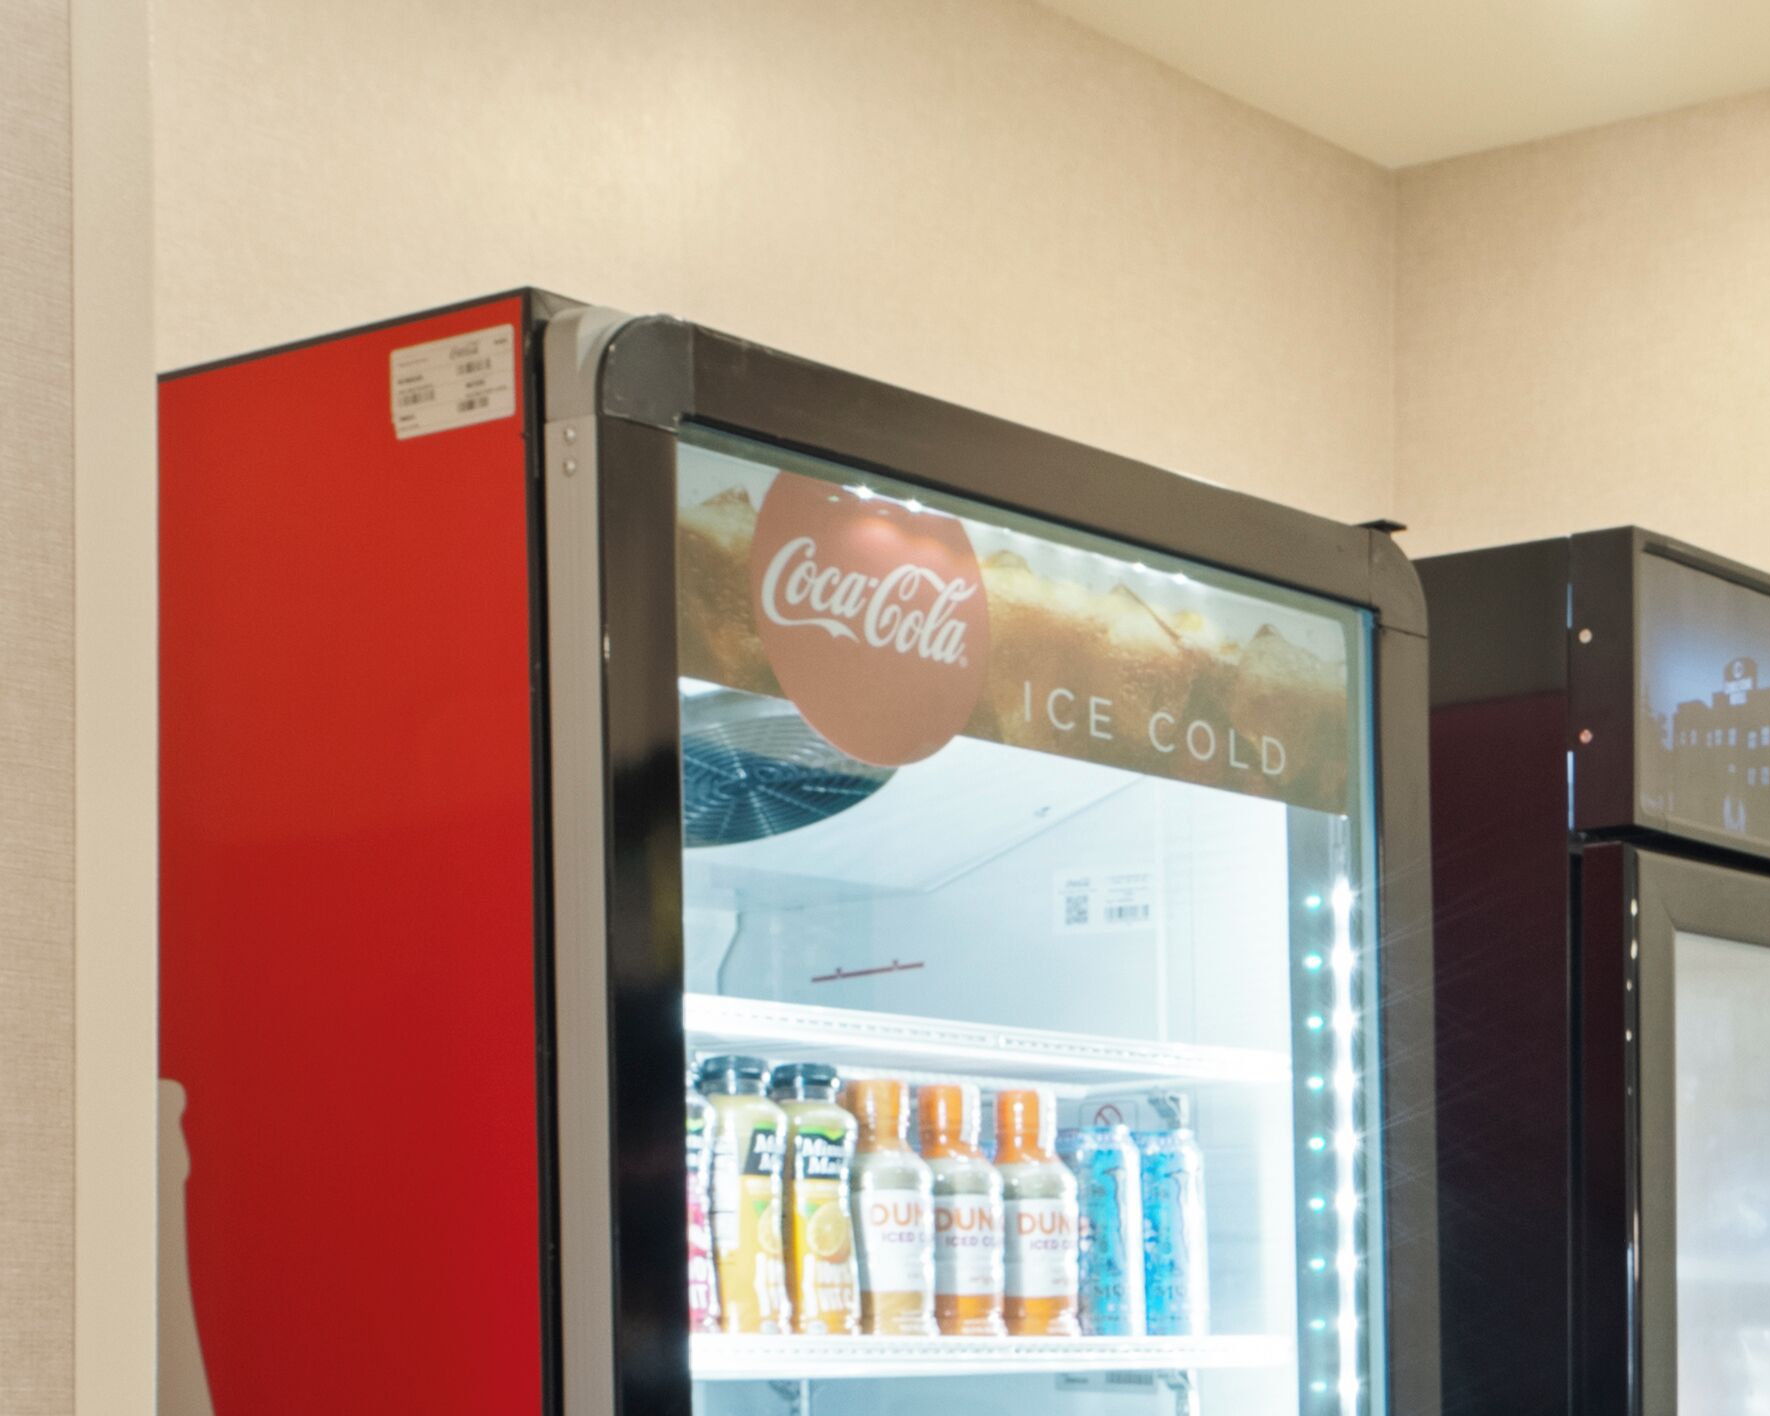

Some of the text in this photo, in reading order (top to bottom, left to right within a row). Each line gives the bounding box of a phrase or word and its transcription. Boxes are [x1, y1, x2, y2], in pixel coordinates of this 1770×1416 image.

[761, 537, 976, 666] Coca-Cola
[1023, 681, 1288, 776] ICE COLD
